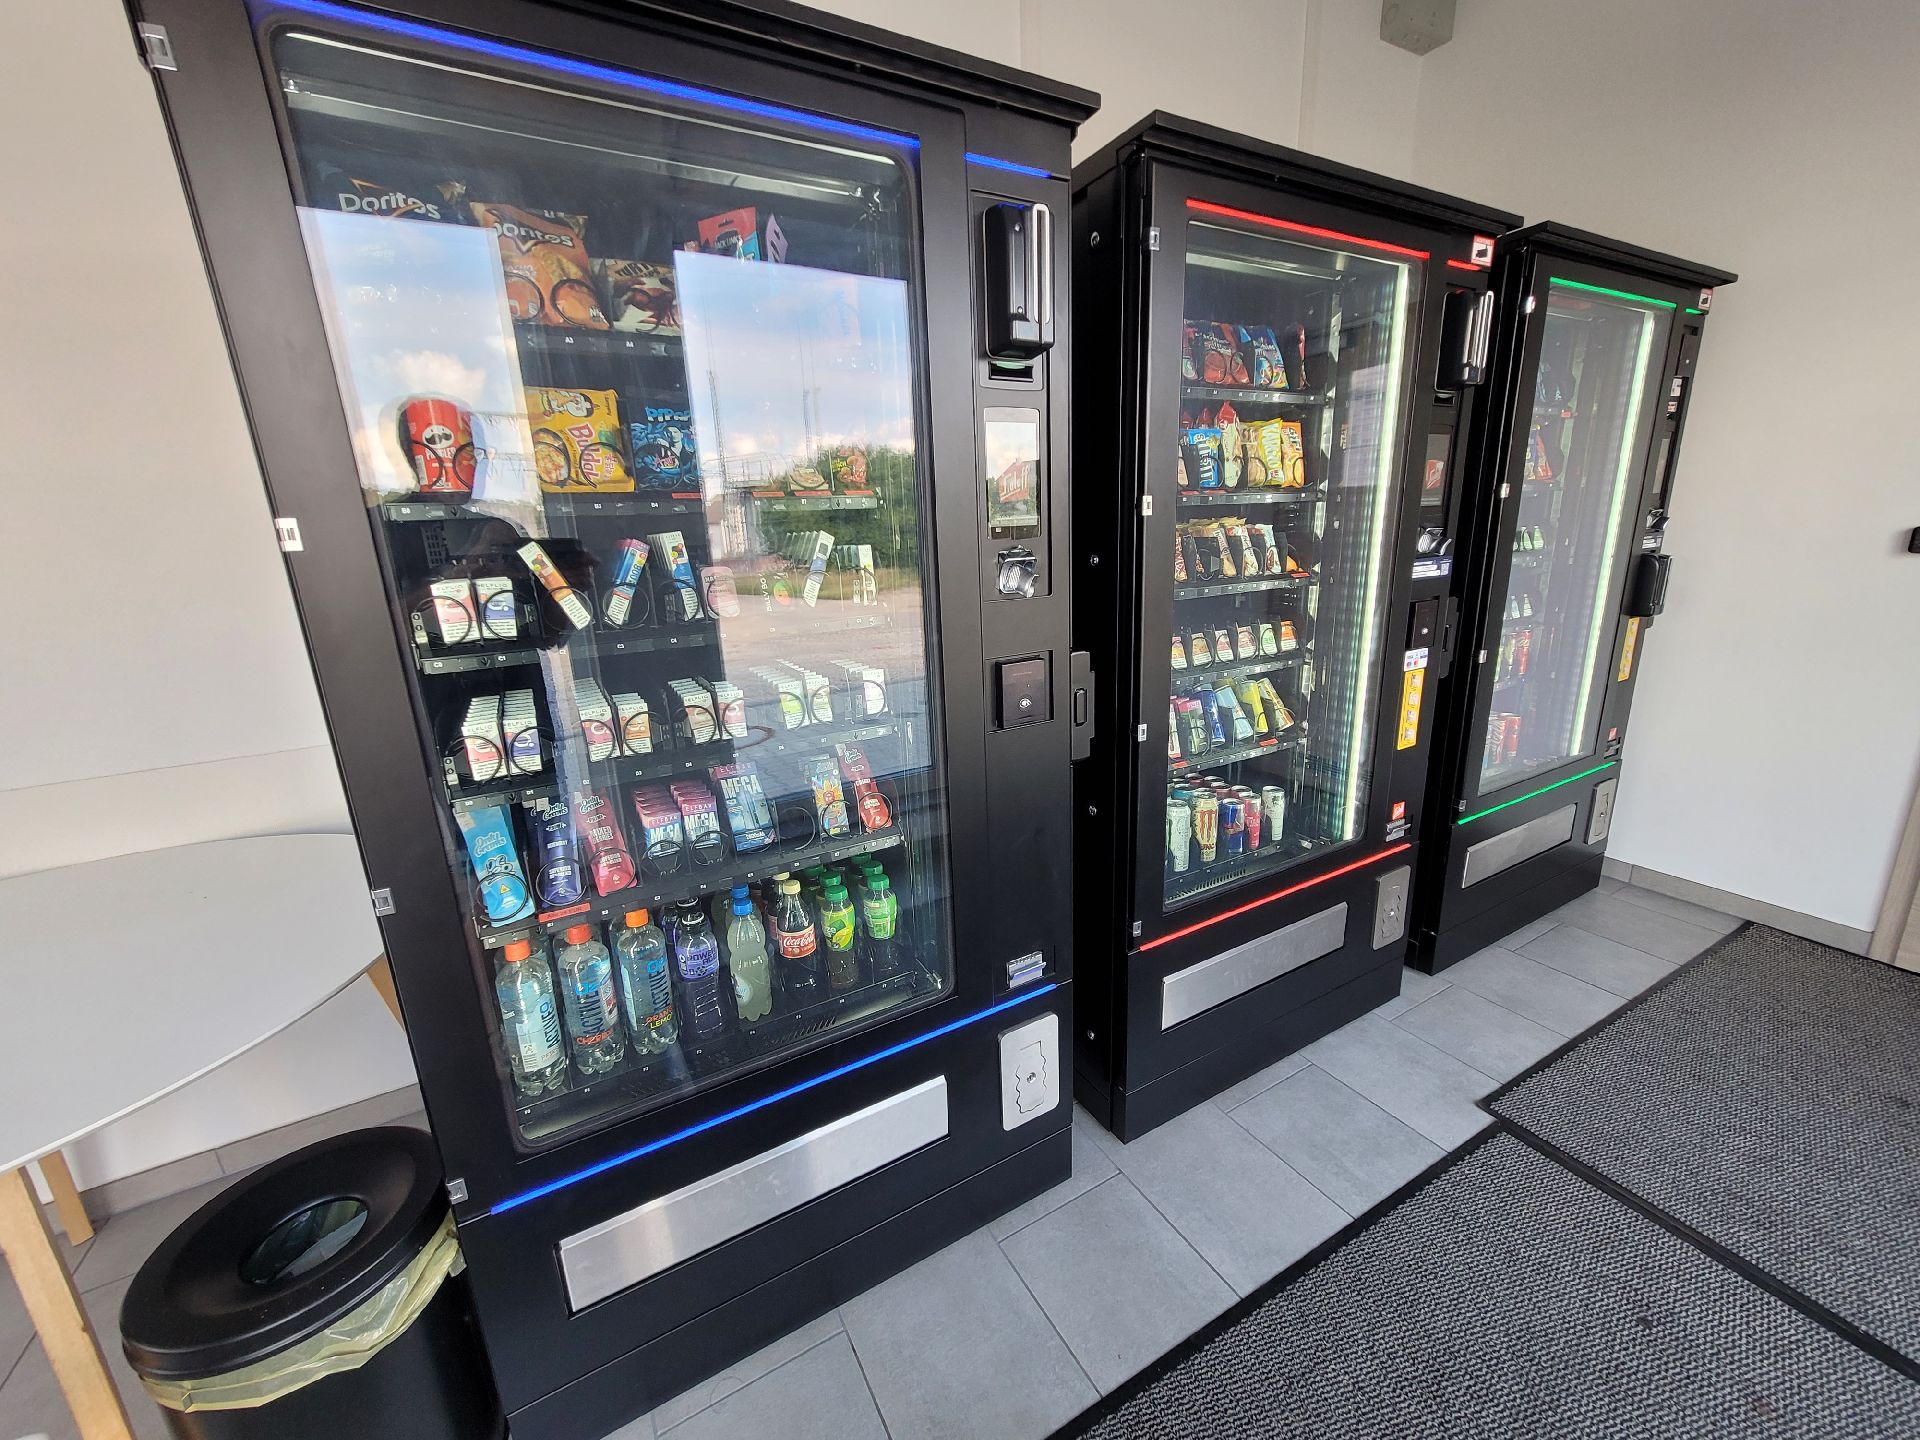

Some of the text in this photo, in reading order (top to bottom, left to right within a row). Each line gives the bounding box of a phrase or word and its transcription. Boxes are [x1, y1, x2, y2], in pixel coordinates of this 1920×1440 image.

[338, 191, 441, 219] Doritos
[567, 422, 603, 487] Buldak
[720, 774, 762, 799] MEGA
[685, 803, 712, 812] ELFBAR
[684, 811, 718, 830] MEGA
[650, 824, 680, 844] MEGA
[783, 929, 815, 948] Coca-Cola
[648, 966, 671, 1013] ACTIVE
[577, 988, 605, 1035] ACTIVE
[650, 1014, 673, 1030] LEMO
[541, 1005, 562, 1050] ACTIVE
